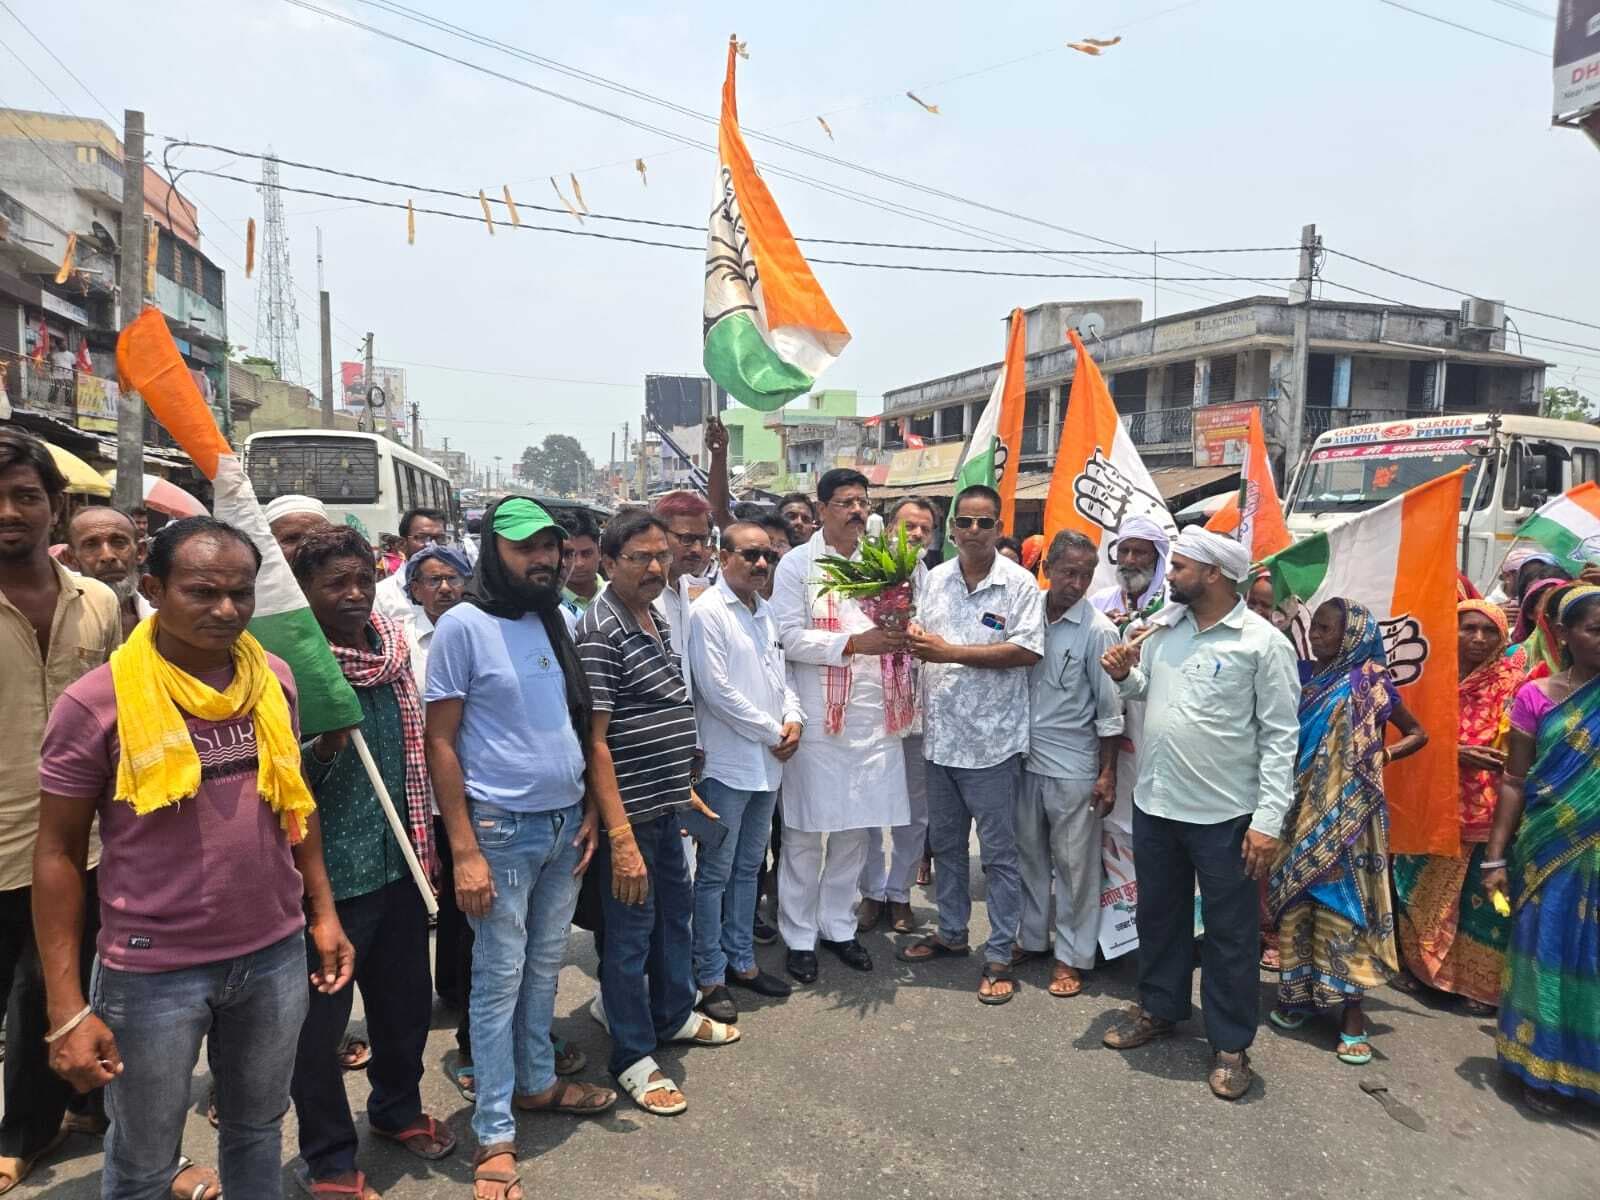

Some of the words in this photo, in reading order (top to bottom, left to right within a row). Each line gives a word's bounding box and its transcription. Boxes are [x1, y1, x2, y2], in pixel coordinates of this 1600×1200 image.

[1334, 425, 1380, 437] GOODS
[1416, 418, 1473, 429] CARRIER
[1351, 433, 1378, 443] INDIA
[1416, 426, 1472, 438] PERMIT
